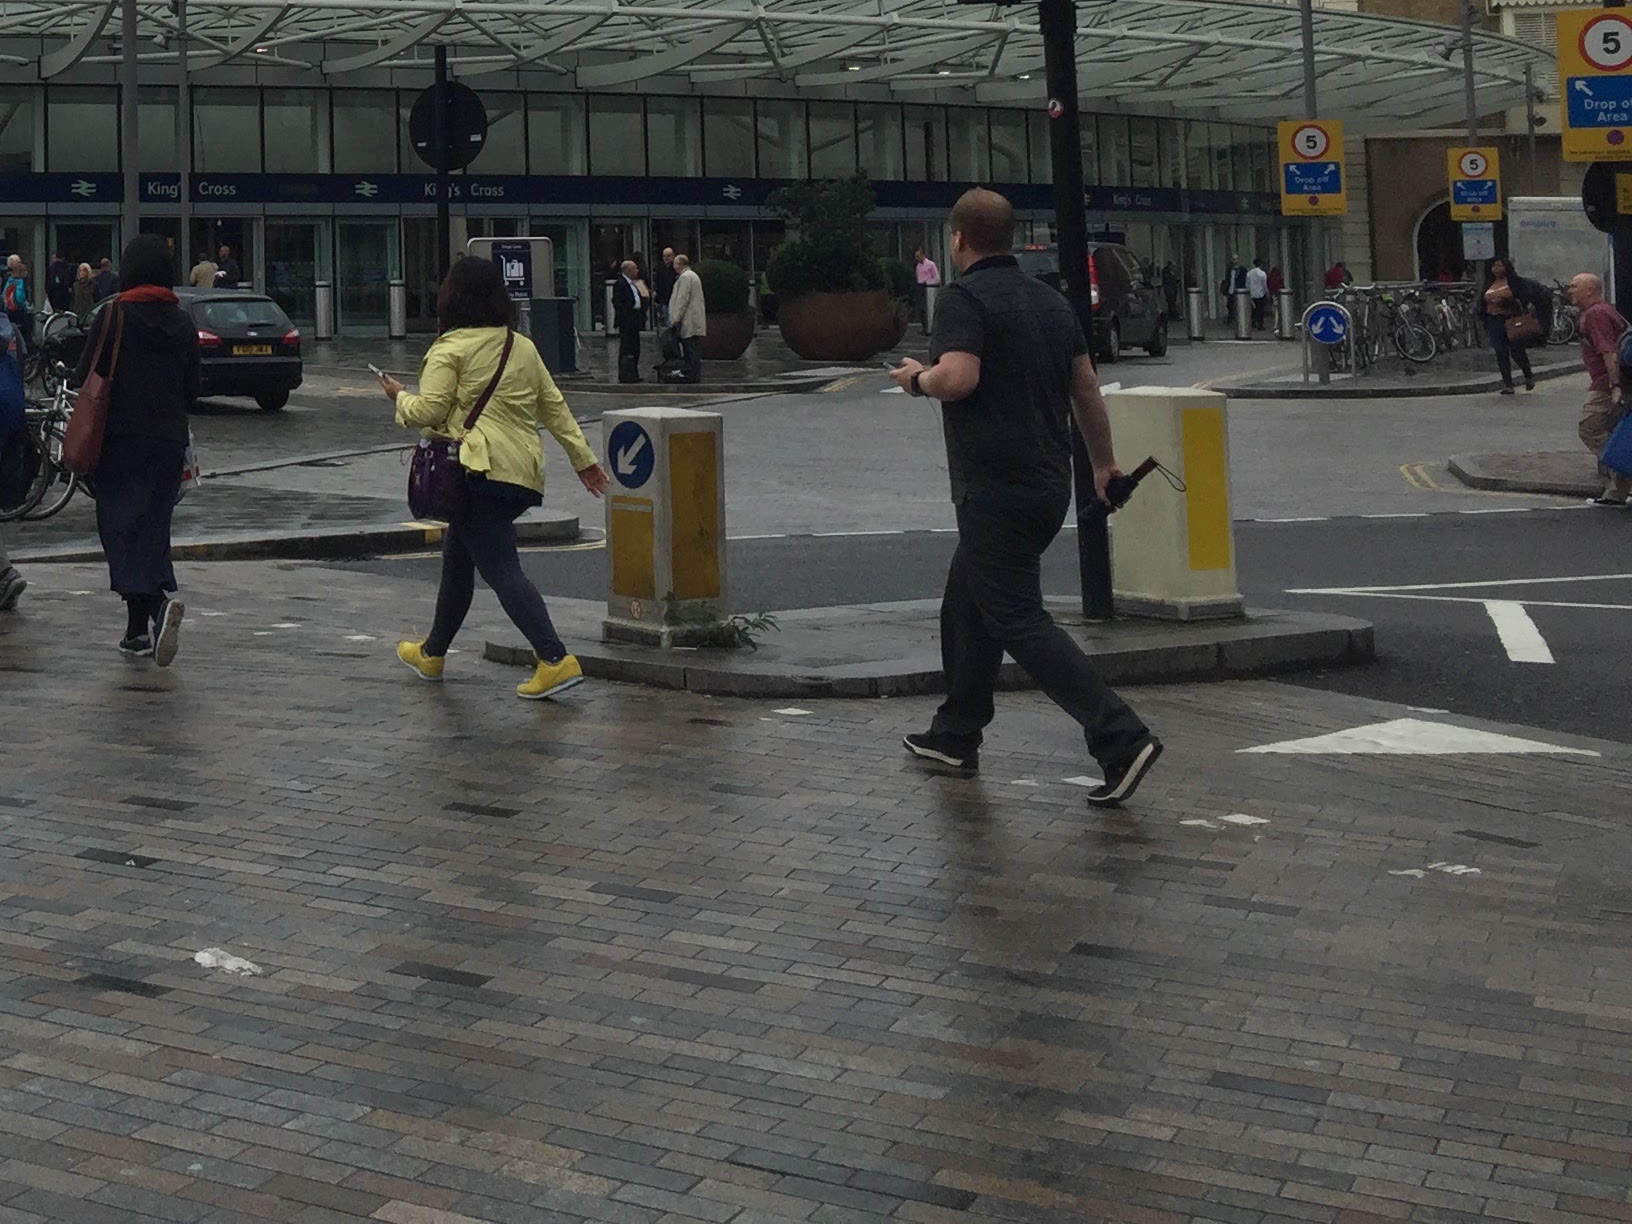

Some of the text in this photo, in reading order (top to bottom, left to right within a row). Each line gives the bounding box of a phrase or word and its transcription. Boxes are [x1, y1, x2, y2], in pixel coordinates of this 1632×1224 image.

[1602, 31, 1622, 55] 5
[1583, 98, 1617, 112] Drop
[1596, 111, 1629, 123] Area
[1305, 134, 1318, 150] 5
[1469, 158, 1480, 171] 5
[1294, 175, 1330, 185] Drop off
[146, 180, 237, 198] King' Cross
[470, 182, 505, 197] Cross
[1302, 184, 1322, 192] Area
